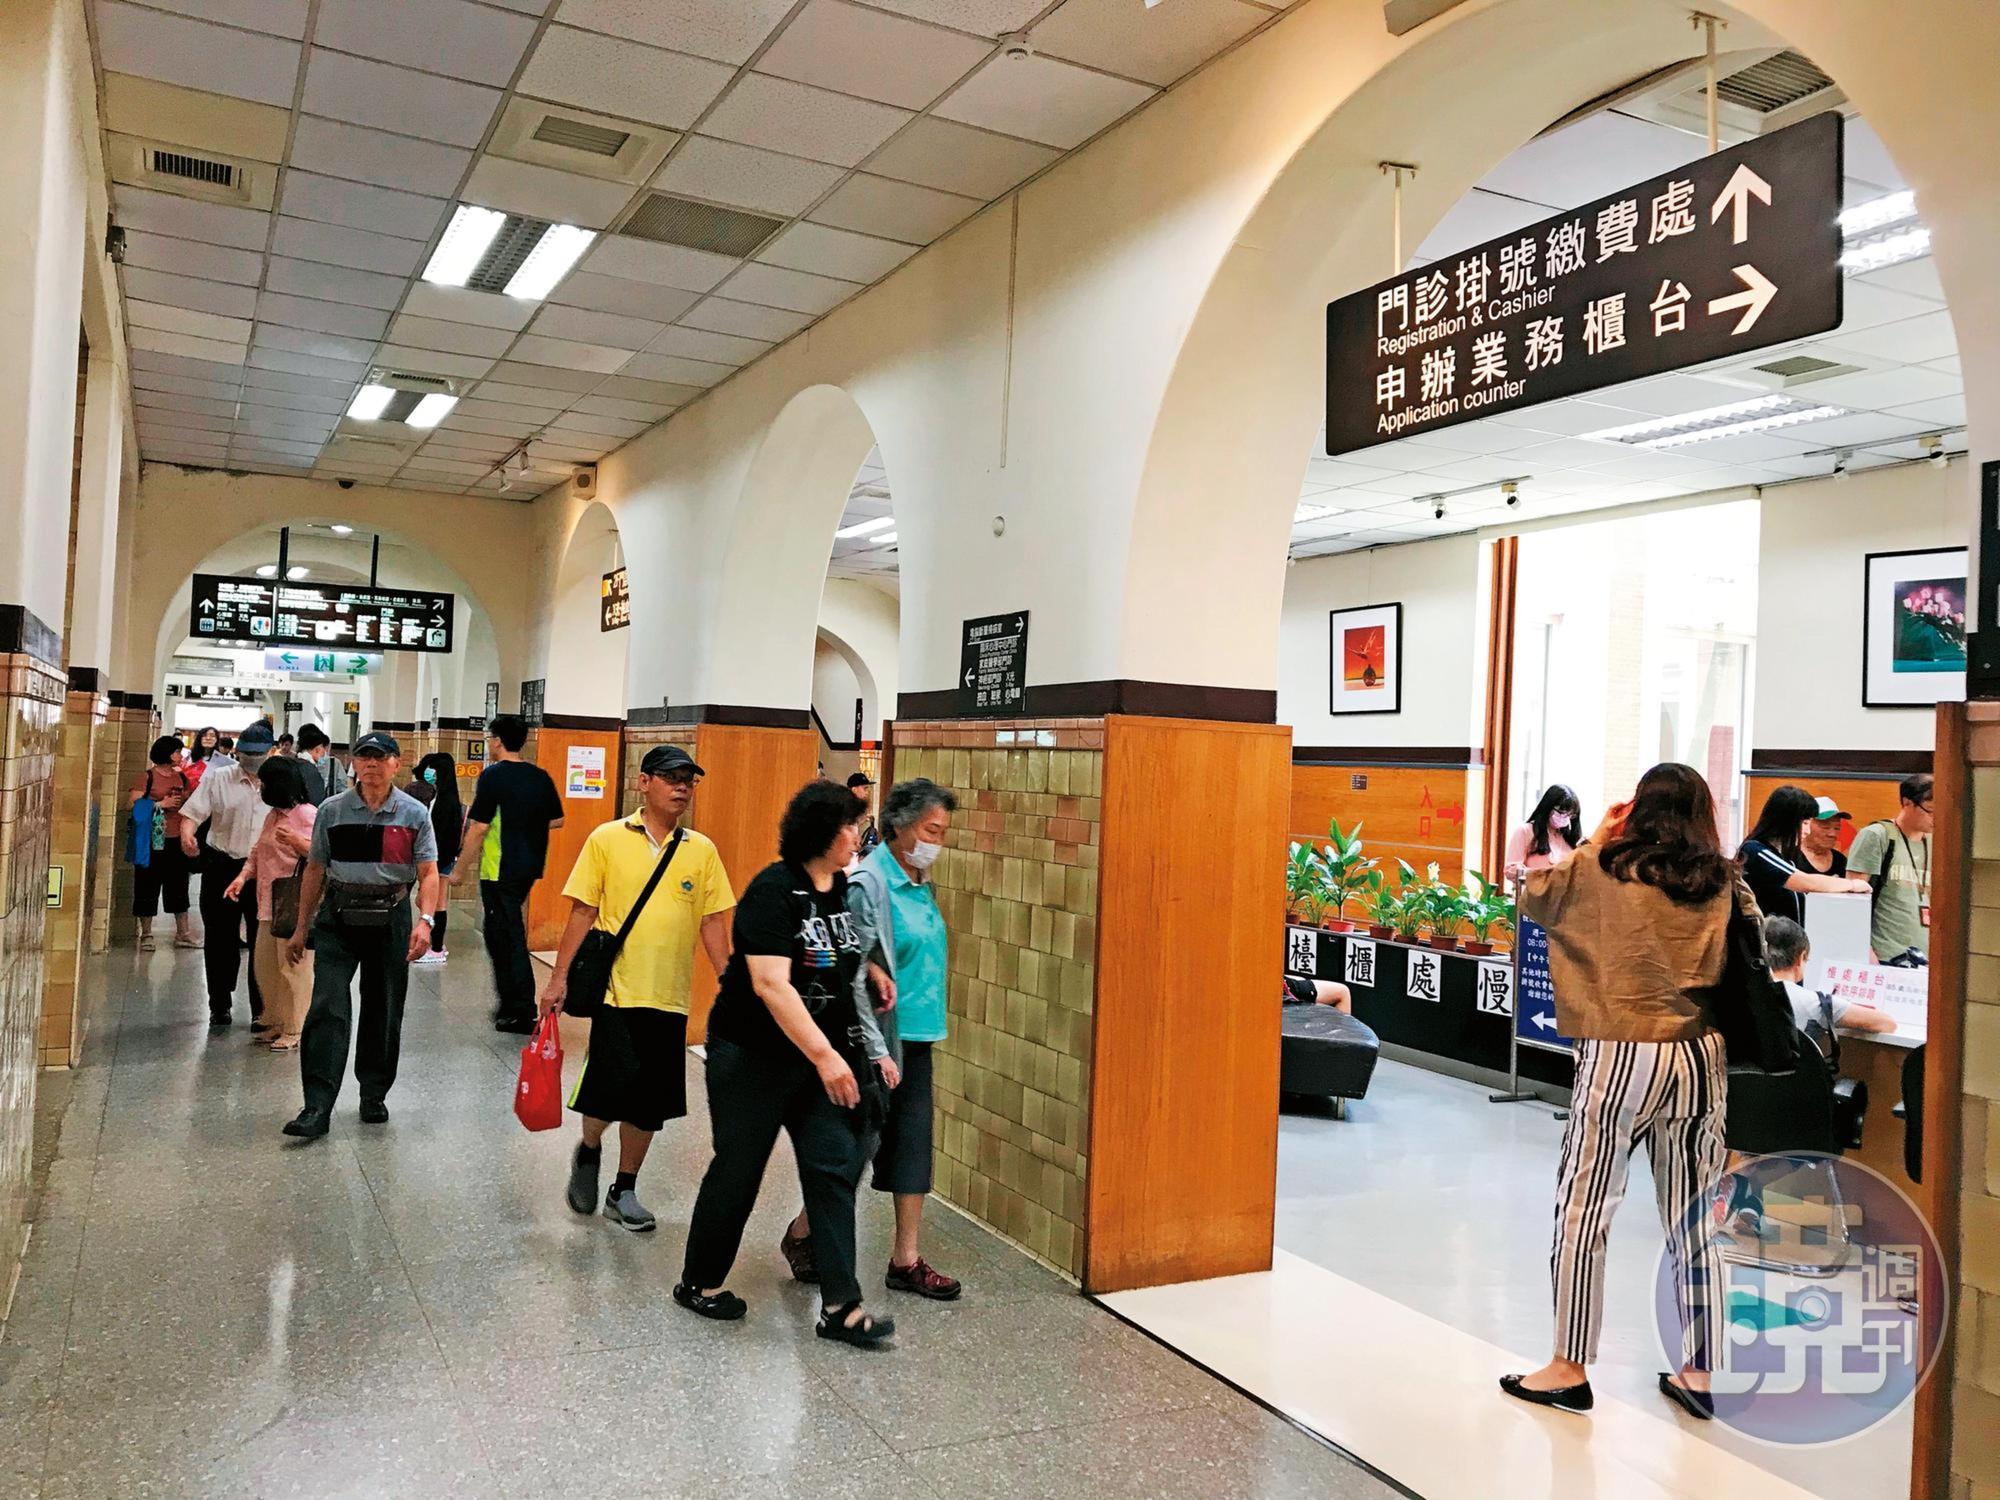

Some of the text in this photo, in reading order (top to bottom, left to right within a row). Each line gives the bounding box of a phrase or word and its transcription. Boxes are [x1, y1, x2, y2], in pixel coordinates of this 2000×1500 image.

[1377, 179, 1697, 338] 門診掛號繳費處
[1376, 278, 1692, 413] 申辦業務櫃台
[1377, 282, 1556, 357] Registration & Cashier
[1377, 377, 1526, 434] Application counter
[1420, 784, 1433, 838] 入口
